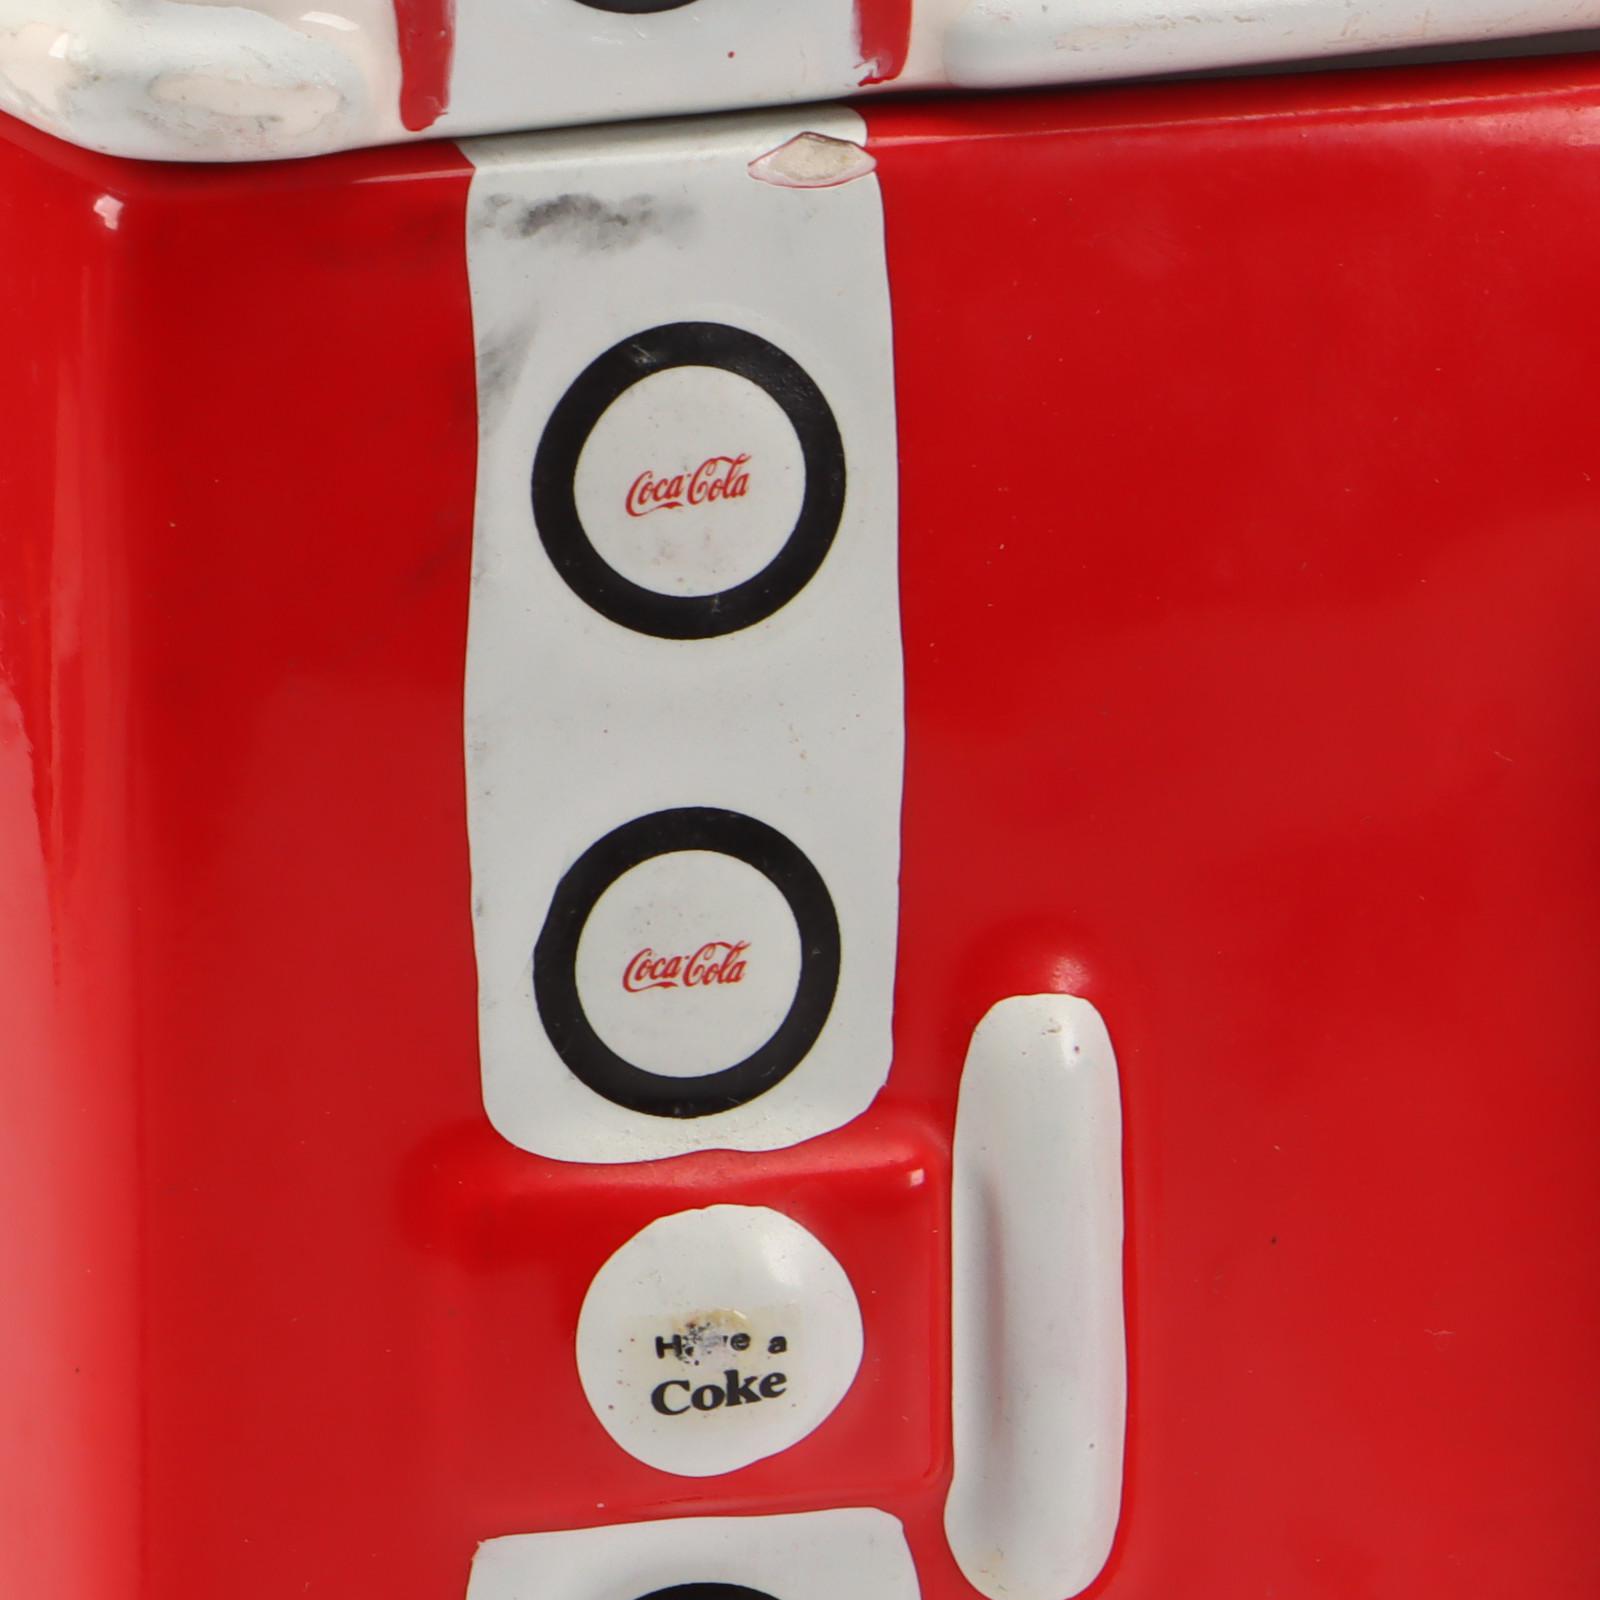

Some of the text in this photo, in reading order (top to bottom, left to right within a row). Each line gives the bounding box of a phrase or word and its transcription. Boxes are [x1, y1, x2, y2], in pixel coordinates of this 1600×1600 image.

[655, 1332, 788, 1361] He a
[650, 1369, 787, 1416] Coke
